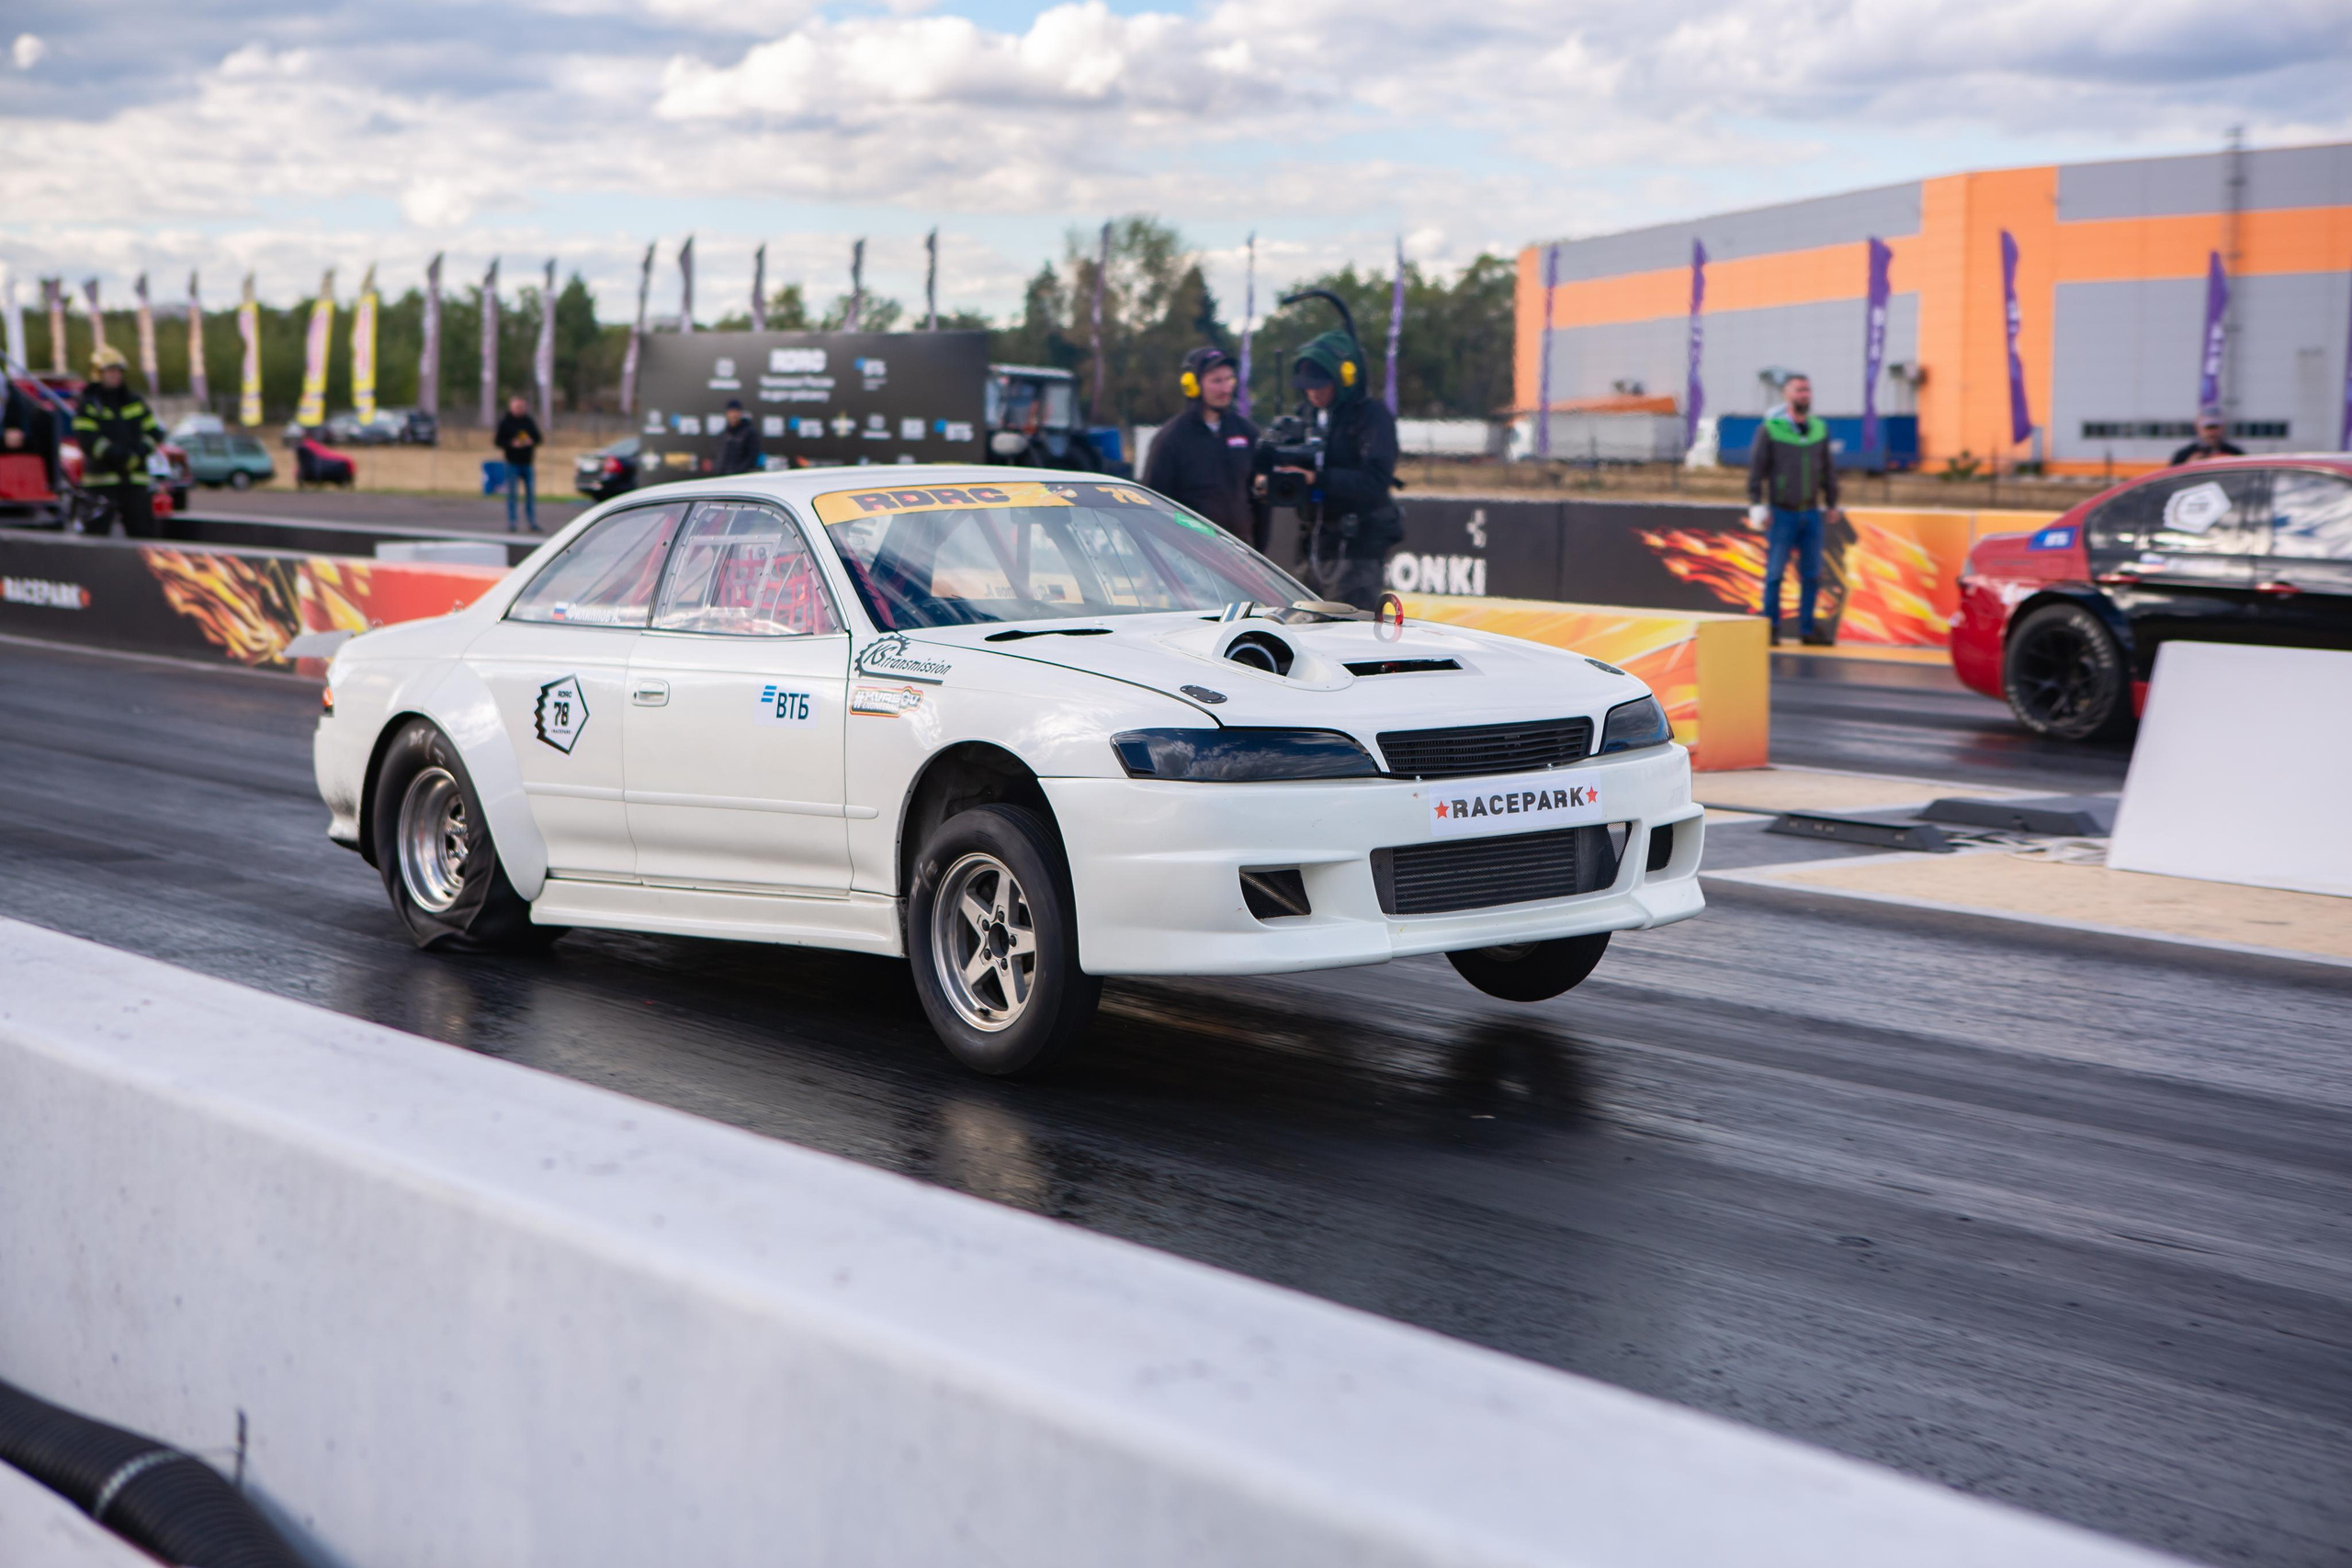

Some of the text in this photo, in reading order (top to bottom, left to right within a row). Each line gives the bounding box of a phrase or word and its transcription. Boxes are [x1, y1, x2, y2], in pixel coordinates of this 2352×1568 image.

[847, 488, 1012, 513] RDRC
[1385, 552, 1487, 595] ONKI
[554, 701, 570, 727] 78
[775, 692, 810, 720] ВТБ
[1451, 786, 1585, 819] RACEPARK
